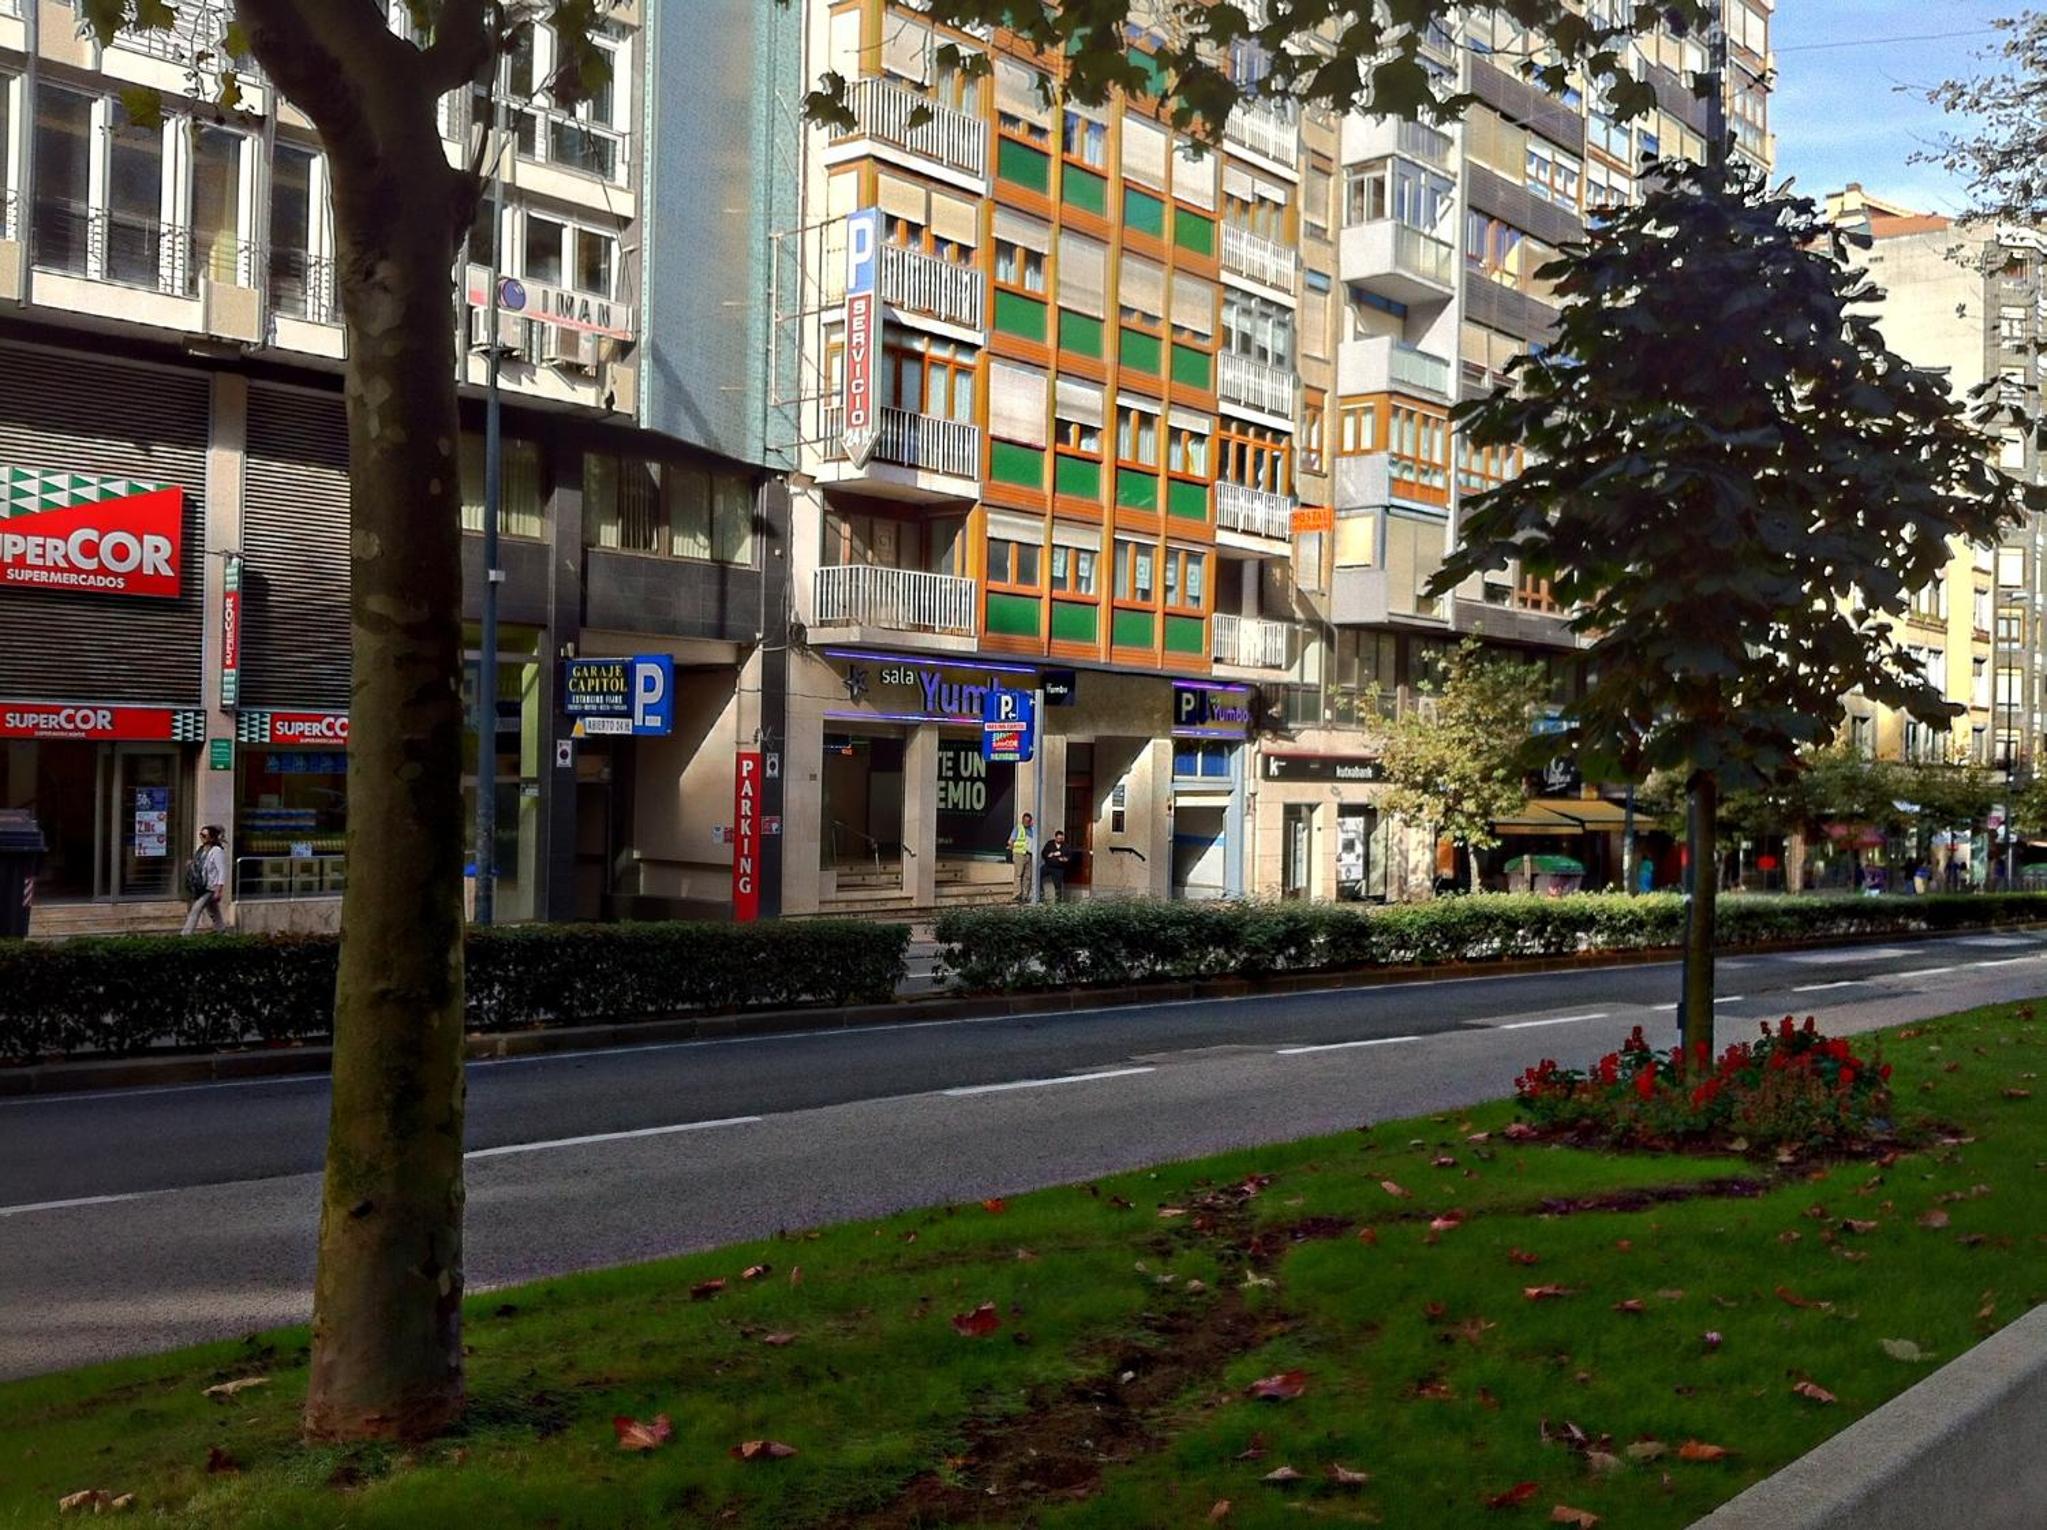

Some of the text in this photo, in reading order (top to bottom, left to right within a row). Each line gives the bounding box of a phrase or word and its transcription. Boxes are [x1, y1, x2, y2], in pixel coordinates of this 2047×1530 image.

[848, 217, 873, 289] P
[542, 289, 611, 328] IMAN
[851, 300, 866, 425] SERVICIO
[0, 529, 175, 577] PERCOR
[7, 568, 125, 589] SUPERMERCADOS
[225, 596, 234, 665] SUPERCOR
[569, 678, 628, 692] CAPITOL
[573, 665, 623, 677] GARAJE
[882, 667, 914, 685] sala
[635, 663, 664, 726] P
[919, 670, 1007, 715] Yum
[1001, 695, 1013, 720] P
[1182, 692, 1195, 722] P
[5, 708, 113, 730] SUPERCOR
[1213, 704, 1249, 722] Yumbo
[961, 751, 986, 778] UN
[739, 760, 753, 893] PARKING
